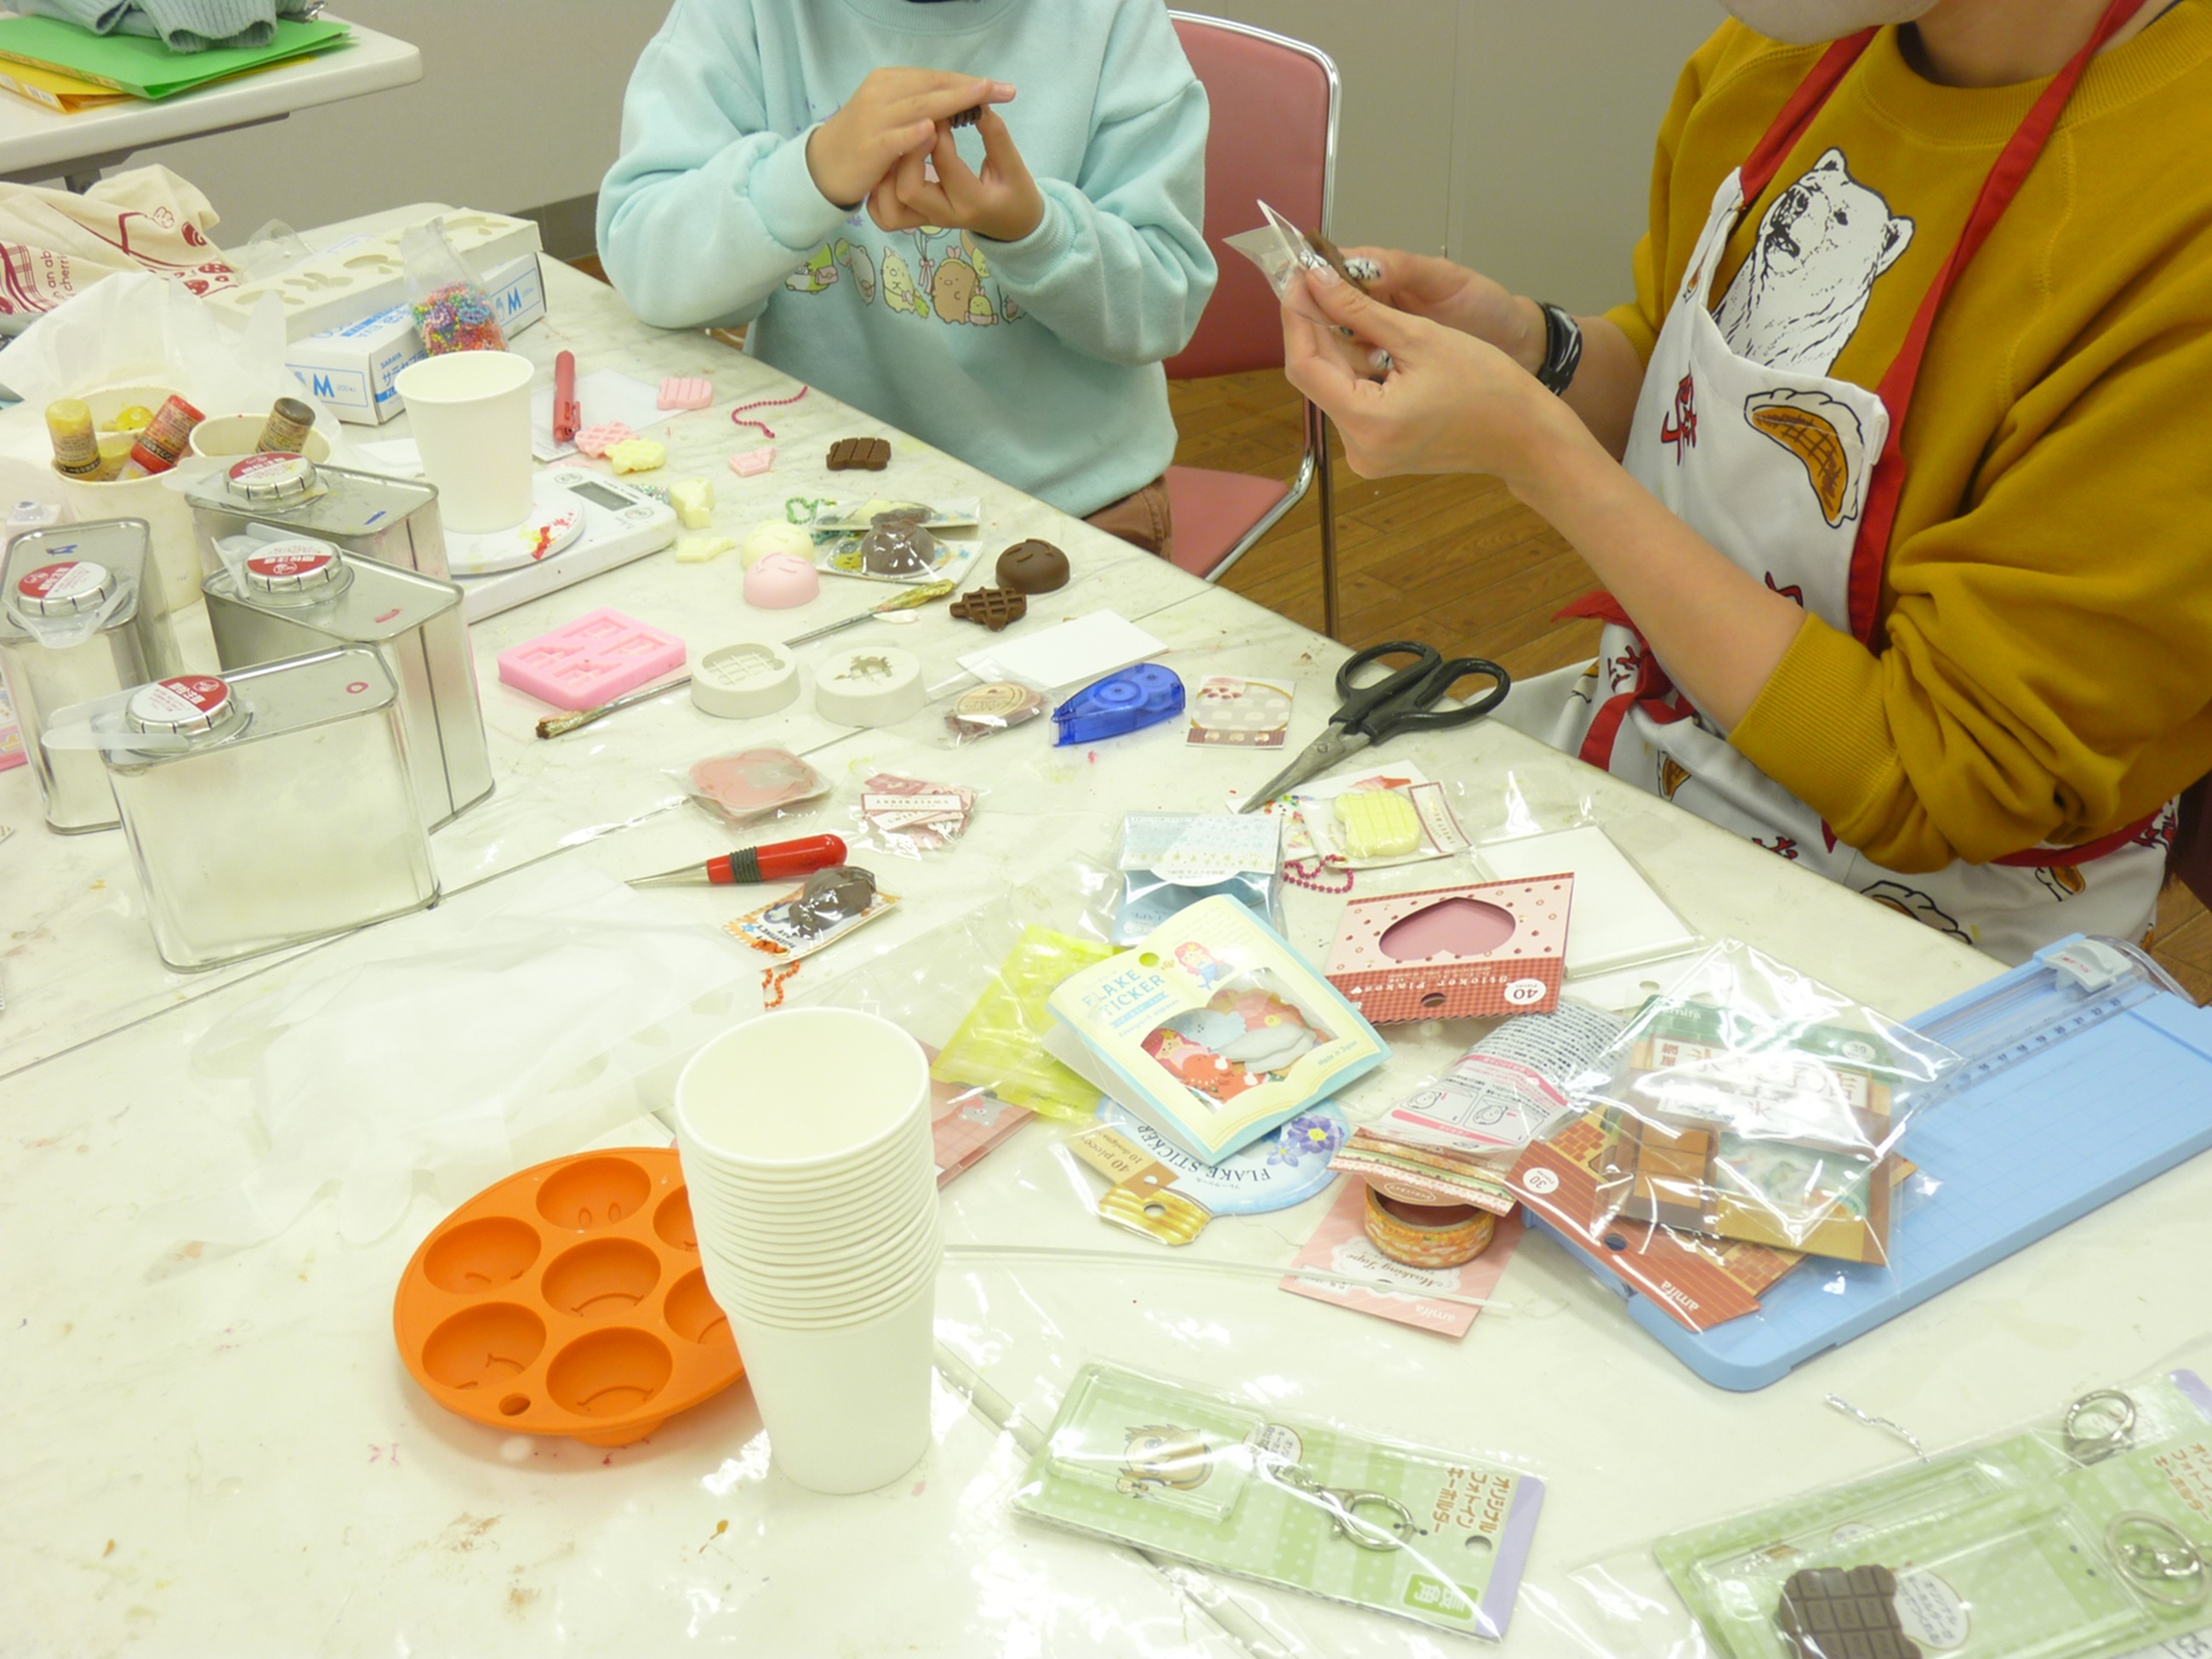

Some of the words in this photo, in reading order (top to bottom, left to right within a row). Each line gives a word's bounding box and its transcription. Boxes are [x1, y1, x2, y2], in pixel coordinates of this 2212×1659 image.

[58, 256, 72, 291] cherri
[507, 287, 522, 315] M
[313, 373, 335, 397] M
[1081, 968, 1141, 1008] FLAKE
[1436, 975, 1509, 988] Sticker
[1513, 989, 1538, 1001] 40
[1089, 973, 1166, 1024] TICKER
[1128, 1153, 1143, 1165] 10
[1137, 1123, 1200, 1172] STICKER
[1110, 1160, 1132, 1173] 40
[1206, 1165, 1273, 1183] FLAKE
[1528, 1173, 1548, 1190] 30
[1346, 1252, 1379, 1270] Tape
[1382, 1262, 1444, 1290] Masking
[1431, 1468, 1464, 1533] キーホルダー
[1457, 1472, 1488, 1531] フォトイン
[1479, 1476, 1511, 1534] オリジナル
